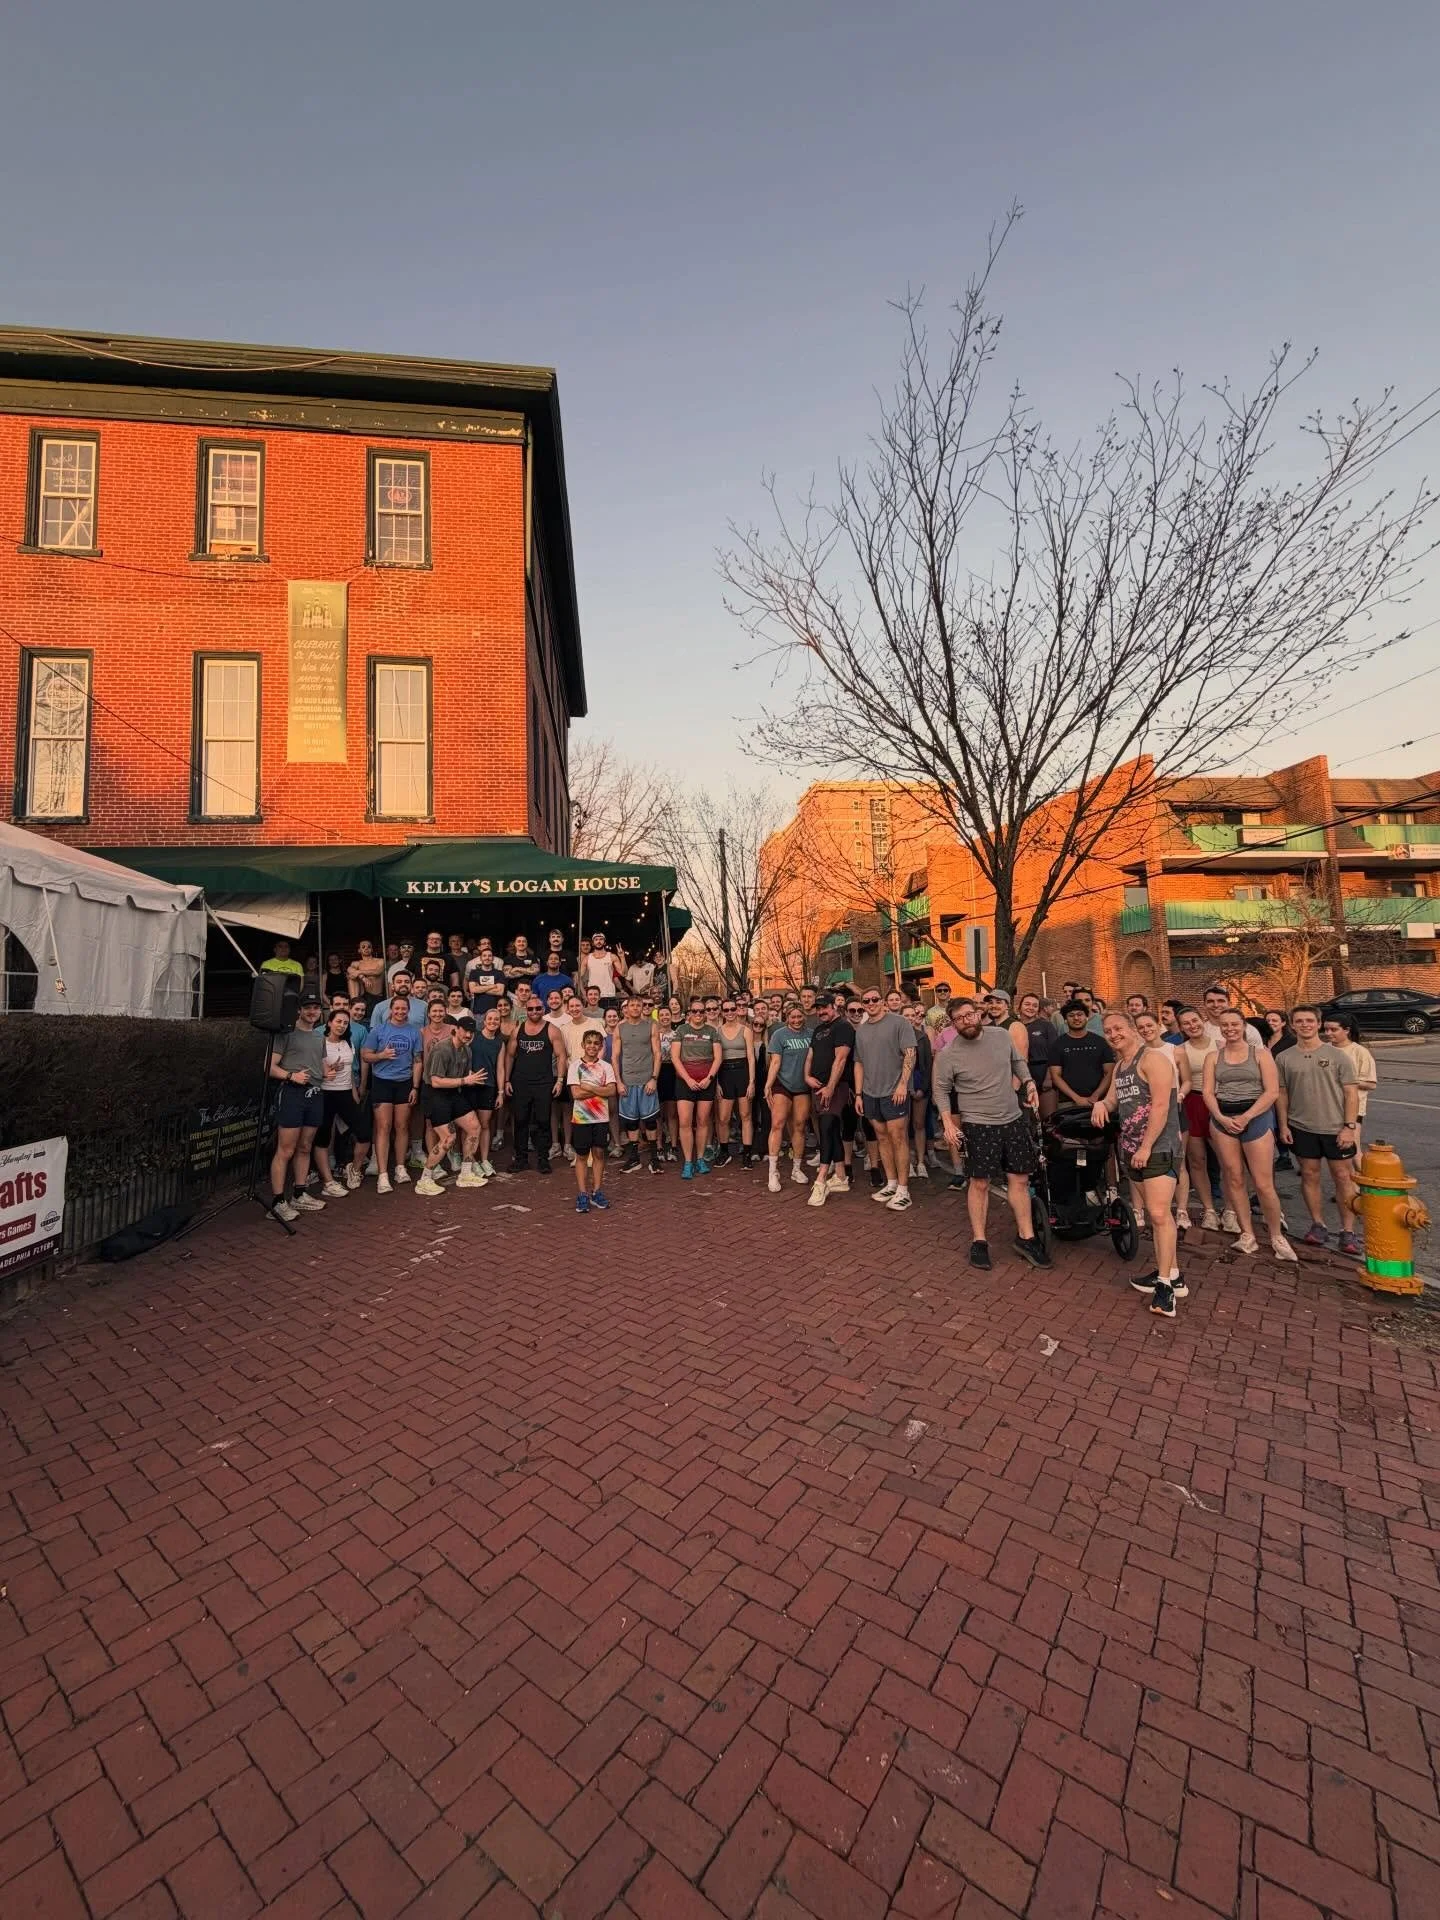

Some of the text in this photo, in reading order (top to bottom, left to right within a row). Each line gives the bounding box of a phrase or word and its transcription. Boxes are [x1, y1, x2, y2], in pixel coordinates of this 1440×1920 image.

[293, 639, 341, 649] CELEBRATE
[406, 876, 641, 894] KELLY'S LOGAN HOUSE
[7, 1221, 32, 1237] Games
[32, 1240, 55, 1256] FLYERS
